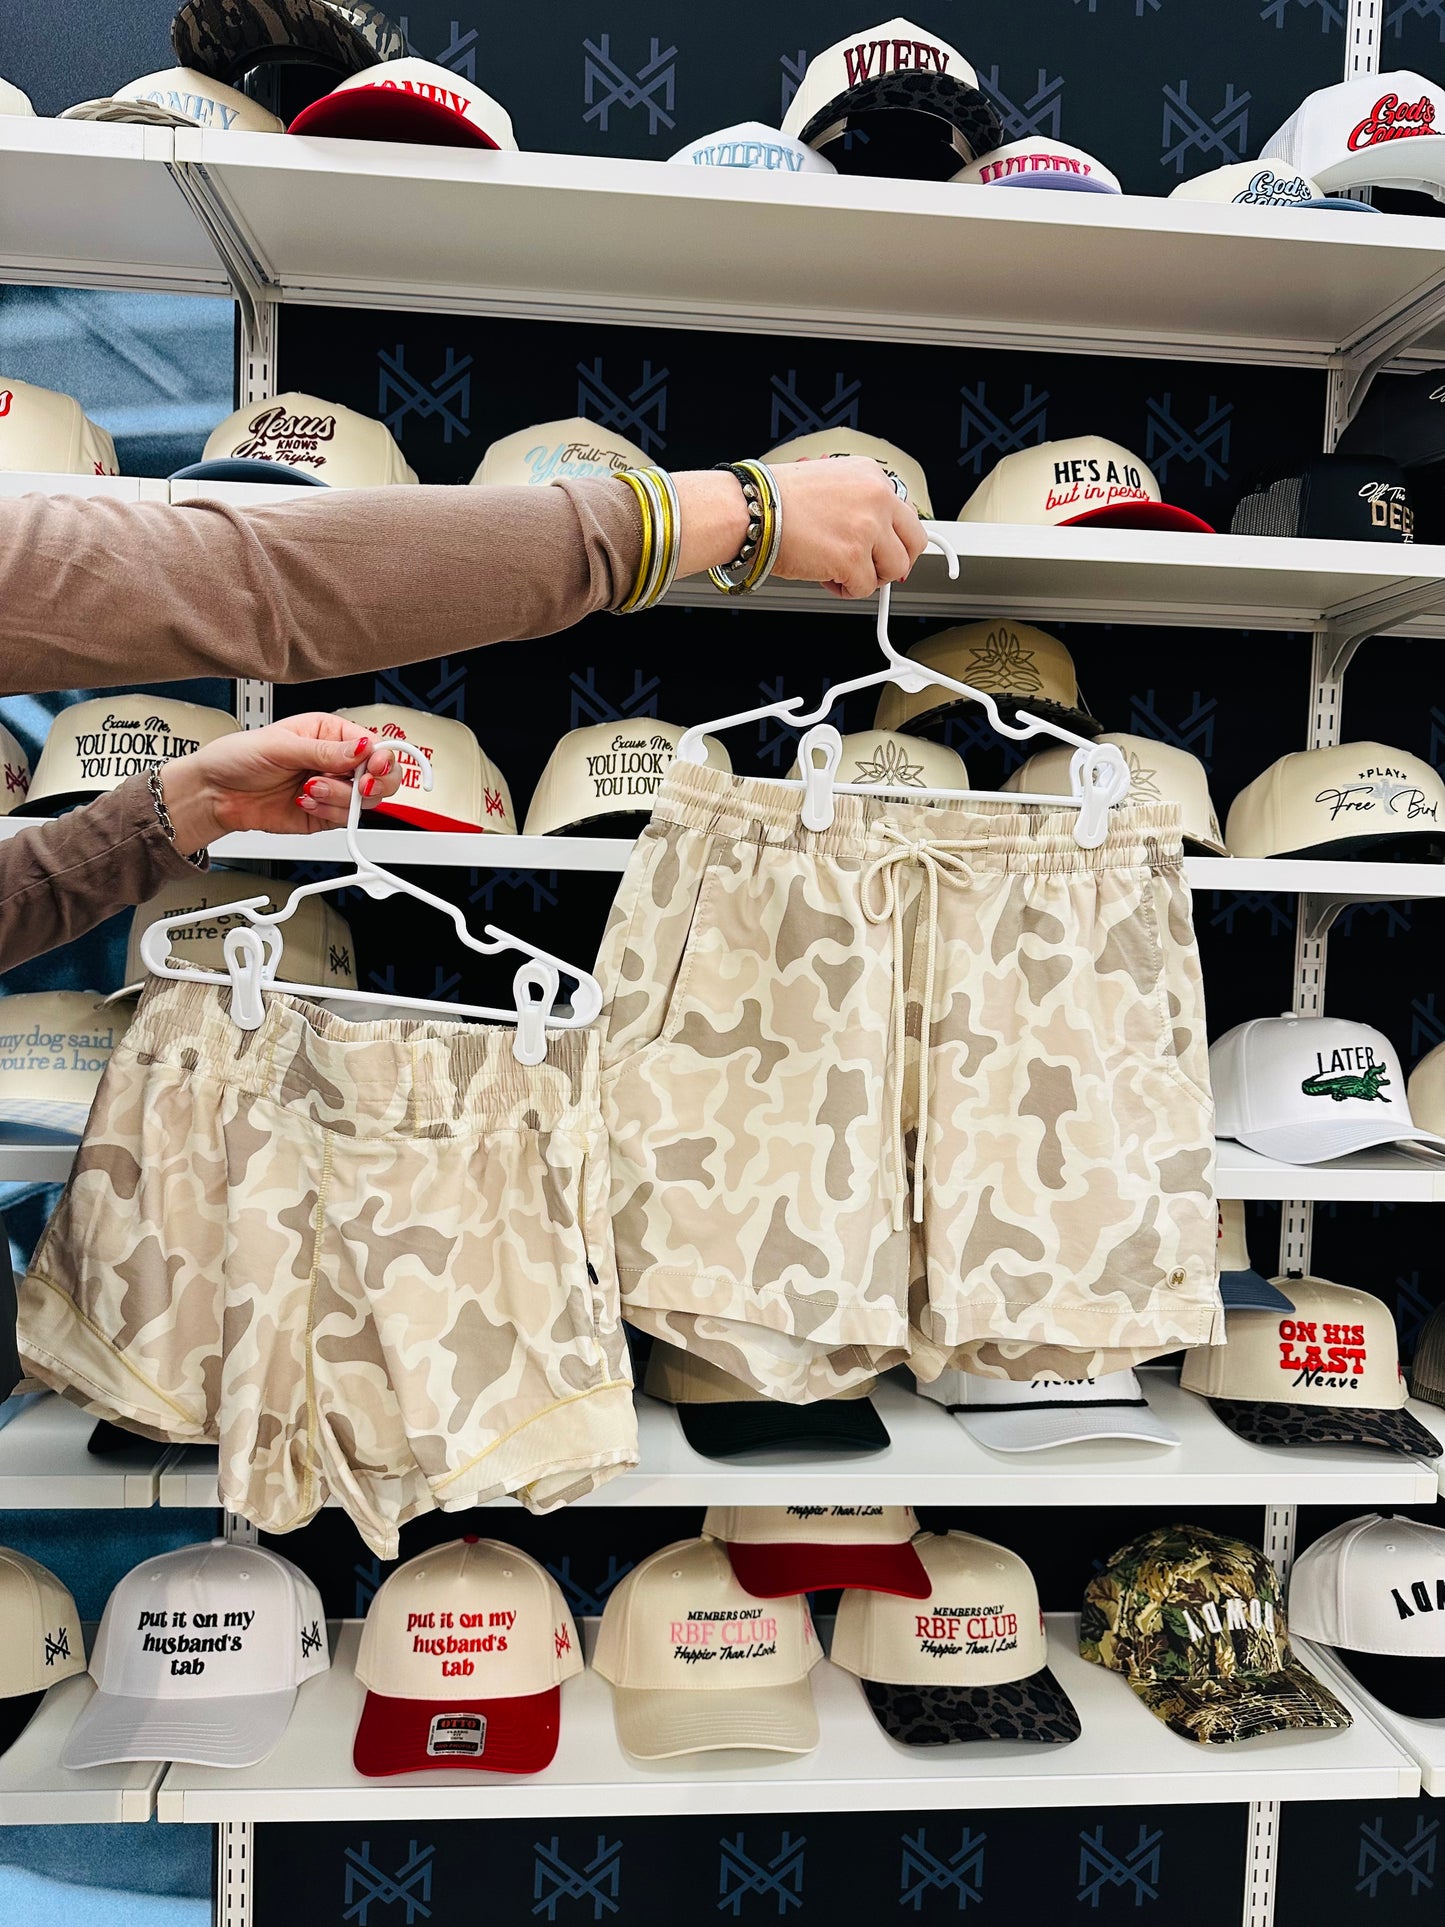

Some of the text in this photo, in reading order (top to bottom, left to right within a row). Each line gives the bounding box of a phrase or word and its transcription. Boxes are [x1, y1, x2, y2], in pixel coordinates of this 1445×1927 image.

[135, 90, 240, 130] ONEY
[1370, 93, 1436, 126] God's
[1248, 170, 1312, 200] God's
[231, 406, 337, 459] Jesus
[276, 440, 318, 450] KNOWS
[275, 450, 328, 468] Trying
[1054, 459, 1142, 489] HE'S A 10
[1045, 483, 1151, 511] but in pesos
[1358, 482, 1390, 503] Off
[102, 714, 171, 733] Excuse Me,
[75, 733, 200, 758] YOU LOOK LIKE
[611, 735, 674, 751] Excuse Me,
[81, 758, 113, 778] YOU
[586, 752, 664, 776] YOU LOOK
[594, 777, 624, 797] YOU
[1315, 786, 1438, 822] Free Bird
[26, 1024, 66, 1053] dog
[68, 1027, 114, 1049] said
[0, 1049, 109, 1071] ou're a ho
[1317, 1046, 1376, 1075] LATER
[1279, 1320, 1365, 1346] ON HIS
[1279, 1343, 1367, 1374] LAST
[1292, 1366, 1359, 1389] Nerve
[137, 1610, 255, 1631] put it on my
[407, 1610, 517, 1632] put it on my
[687, 1608, 763, 1621] MEMBERS ONLY
[933, 1604, 1005, 1617] MEMBERS ONLY
[670, 1618, 778, 1645] RBF CLUB
[915, 1613, 1018, 1640] RBF CLUB
[142, 1632, 243, 1655] husband's
[413, 1634, 508, 1656] husband's
[674, 1645, 717, 1664] Happier
[719, 1645, 745, 1660] Than
[752, 1641, 777, 1658] Look
[920, 1640, 963, 1658] Happier
[965, 1641, 989, 1654] Than
[996, 1635, 1018, 1652] Look
[171, 1657, 205, 1676] tab
[441, 1658, 475, 1677] tab
[441, 1719, 477, 1728] OTTO
